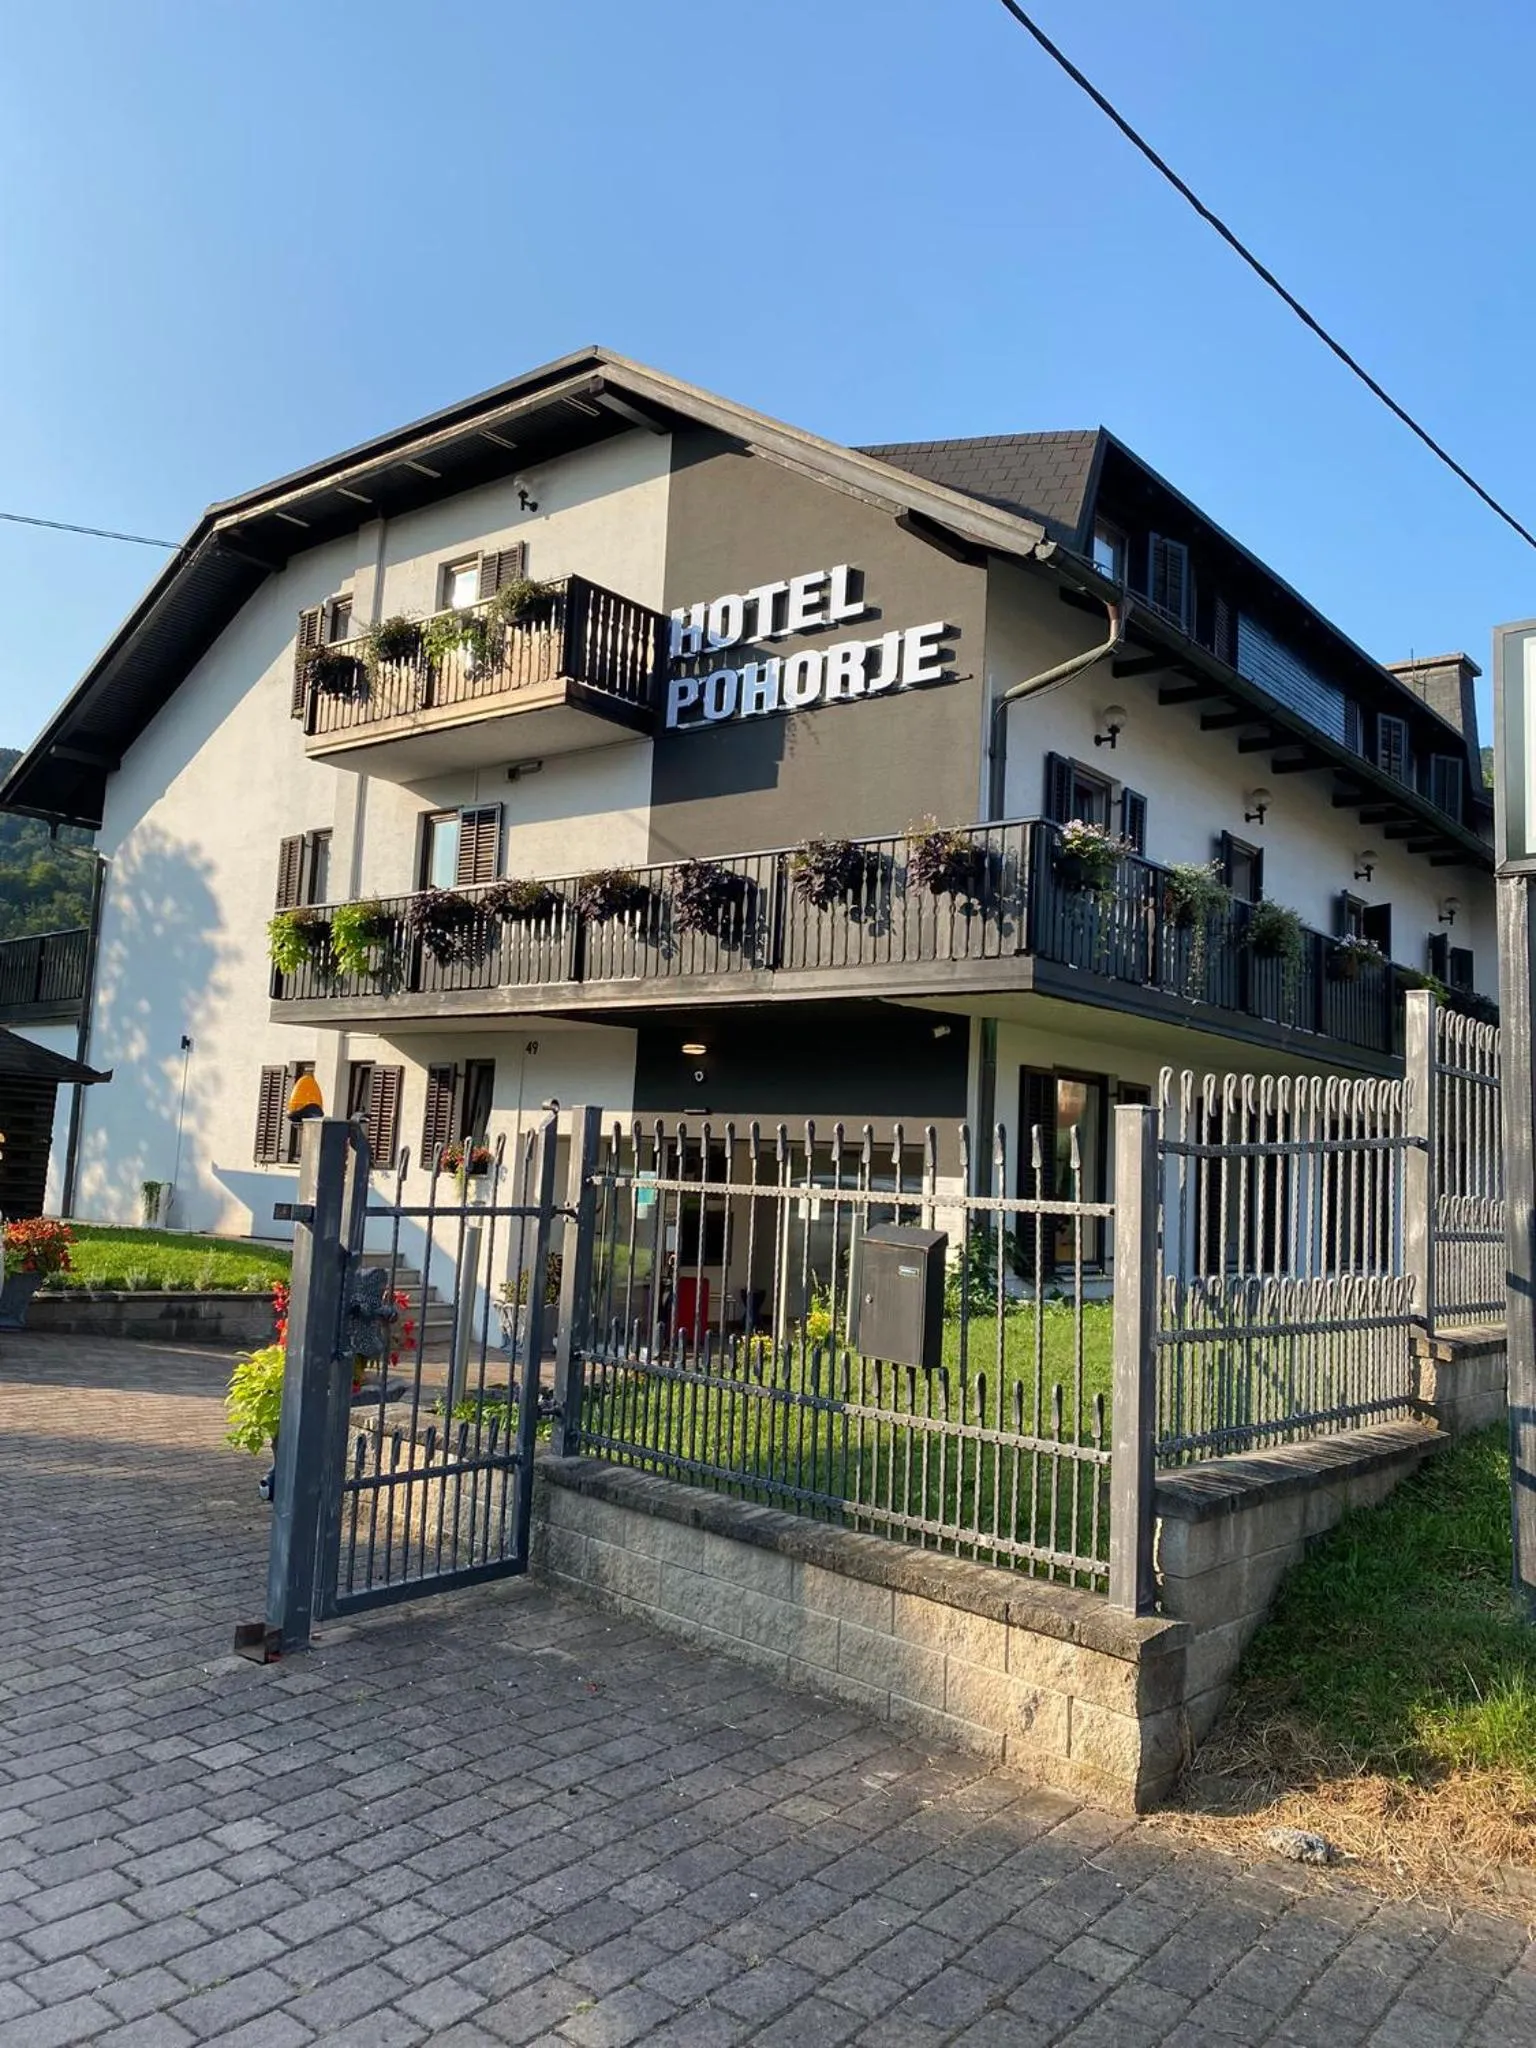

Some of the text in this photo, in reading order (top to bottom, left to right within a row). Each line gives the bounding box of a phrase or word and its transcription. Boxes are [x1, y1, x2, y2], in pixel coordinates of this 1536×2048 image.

[670, 564, 864, 659] HOTEL
[666, 621, 945, 729] POHORJE
[525, 1040, 539, 1055] 49
